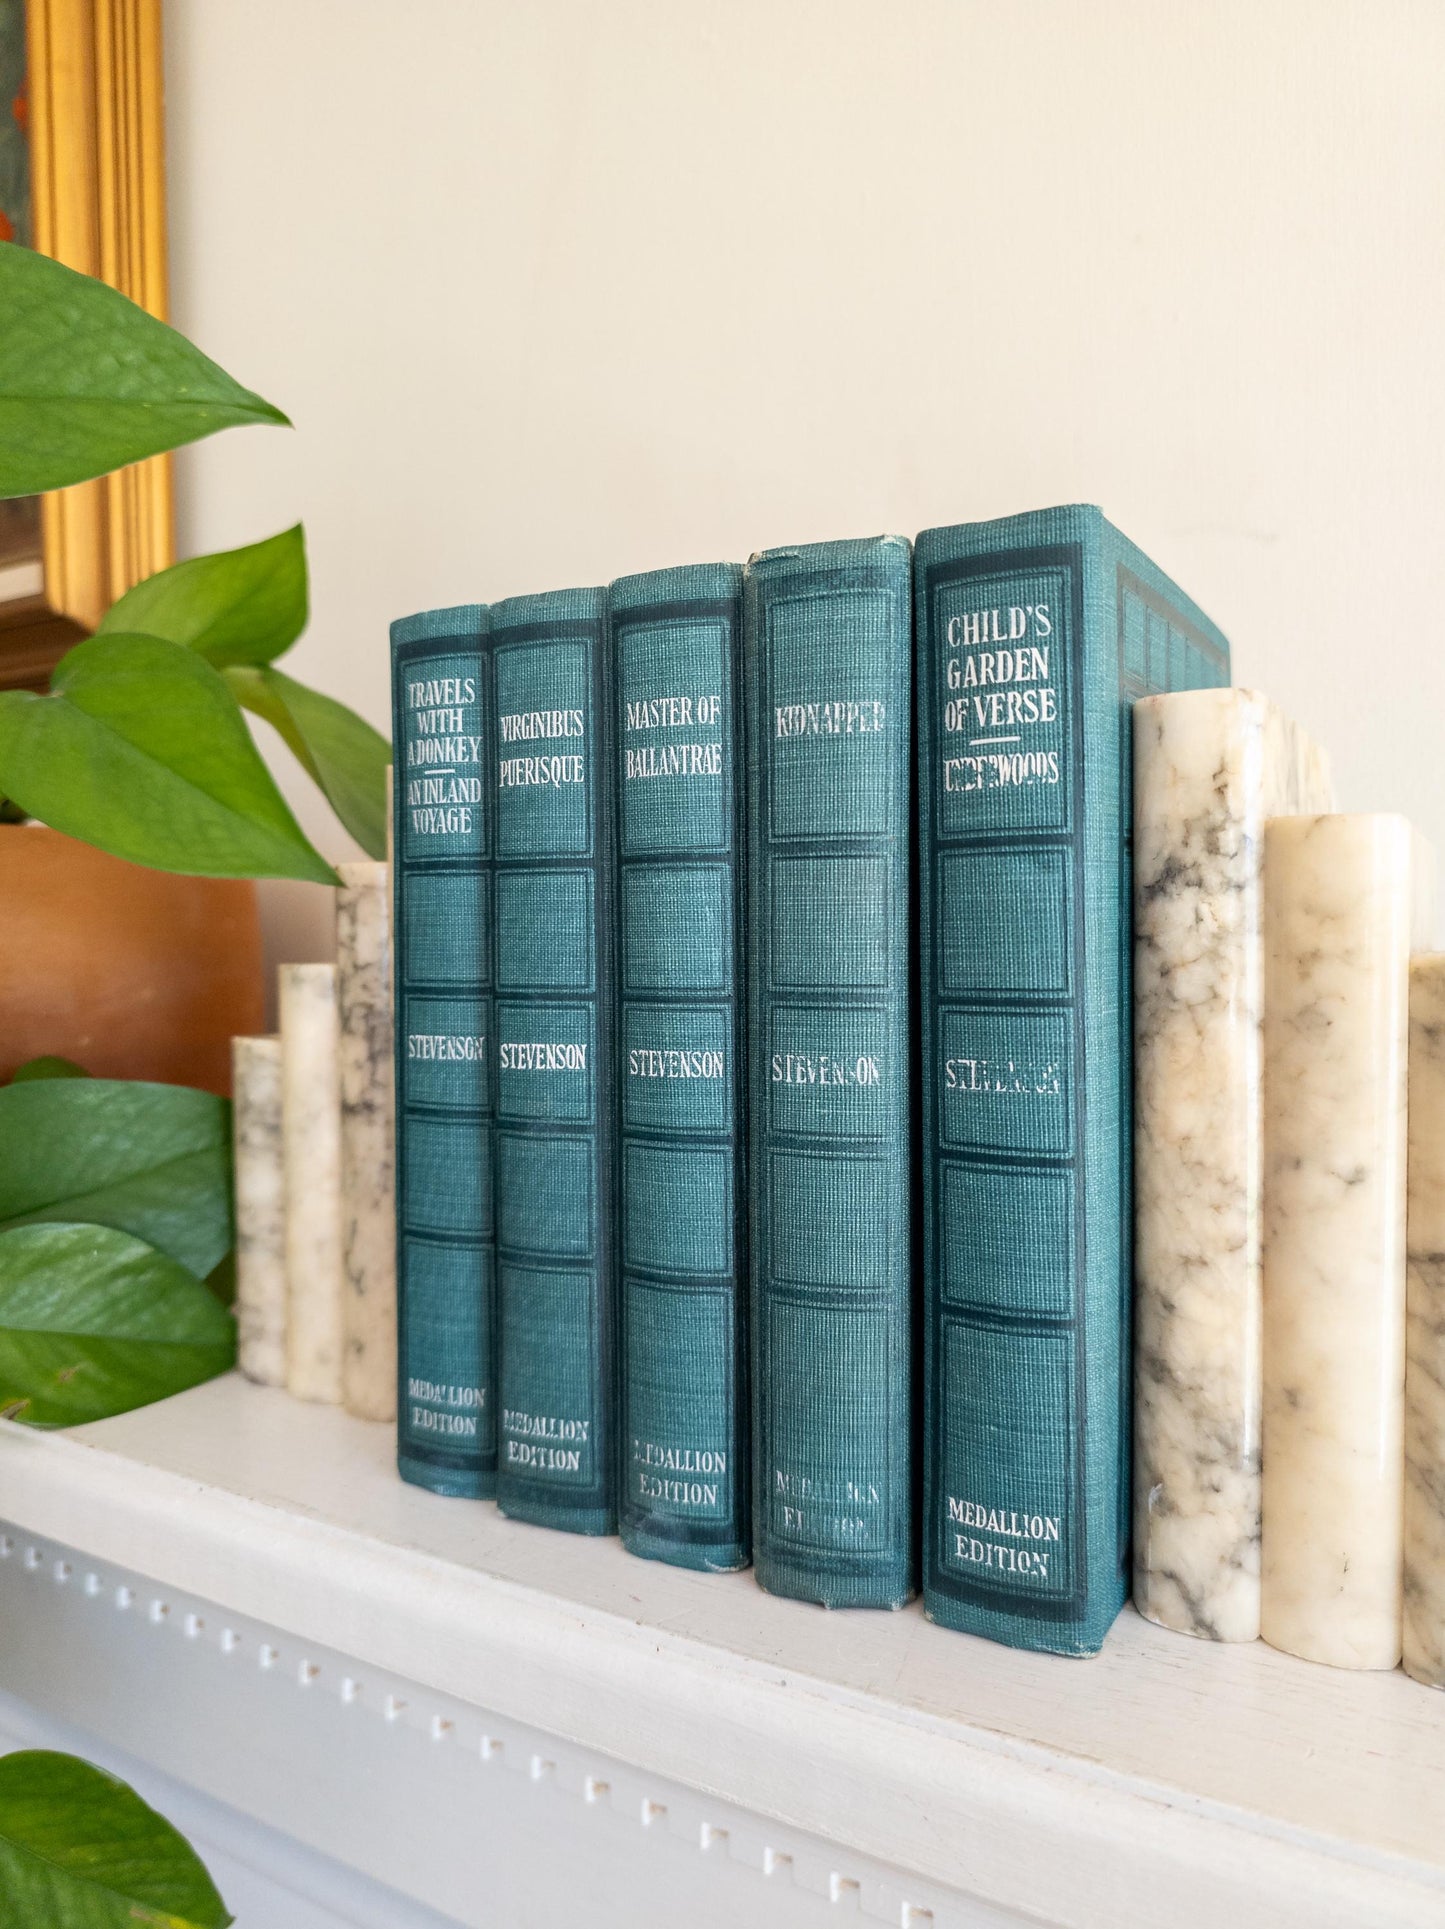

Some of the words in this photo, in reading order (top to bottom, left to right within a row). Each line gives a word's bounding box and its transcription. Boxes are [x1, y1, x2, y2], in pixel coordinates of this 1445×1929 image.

[948, 604, 1052, 647] CHILD'S
[947, 647, 1050, 690] GARDEN
[409, 678, 476, 709] TRAVELS
[417, 708, 464, 734] WITH
[626, 696, 694, 731] MASTER
[697, 695, 721, 725] OF
[944, 698, 969, 732] OF
[974, 688, 1058, 728] VERSE
[500, 710, 584, 743] VIRGINIBUS
[407, 741, 415, 766] A
[416, 736, 483, 765] DONKEY
[625, 742, 723, 779] BALLANTRAE
[499, 755, 584, 788] PUERISQUE
[408, 778, 422, 806] AN
[423, 777, 482, 805] INLAND
[412, 807, 473, 834] VOYAGE
[408, 1034, 485, 1061] STEVENSON
[500, 1043, 587, 1070] STEVENSON
[629, 1049, 724, 1078] STEVENSON
[413, 1406, 478, 1436] EDITION
[508, 1440, 581, 1471] EDITION
[947, 1496, 1061, 1541] MEDALLION
[955, 1534, 1050, 1576] EDITION
